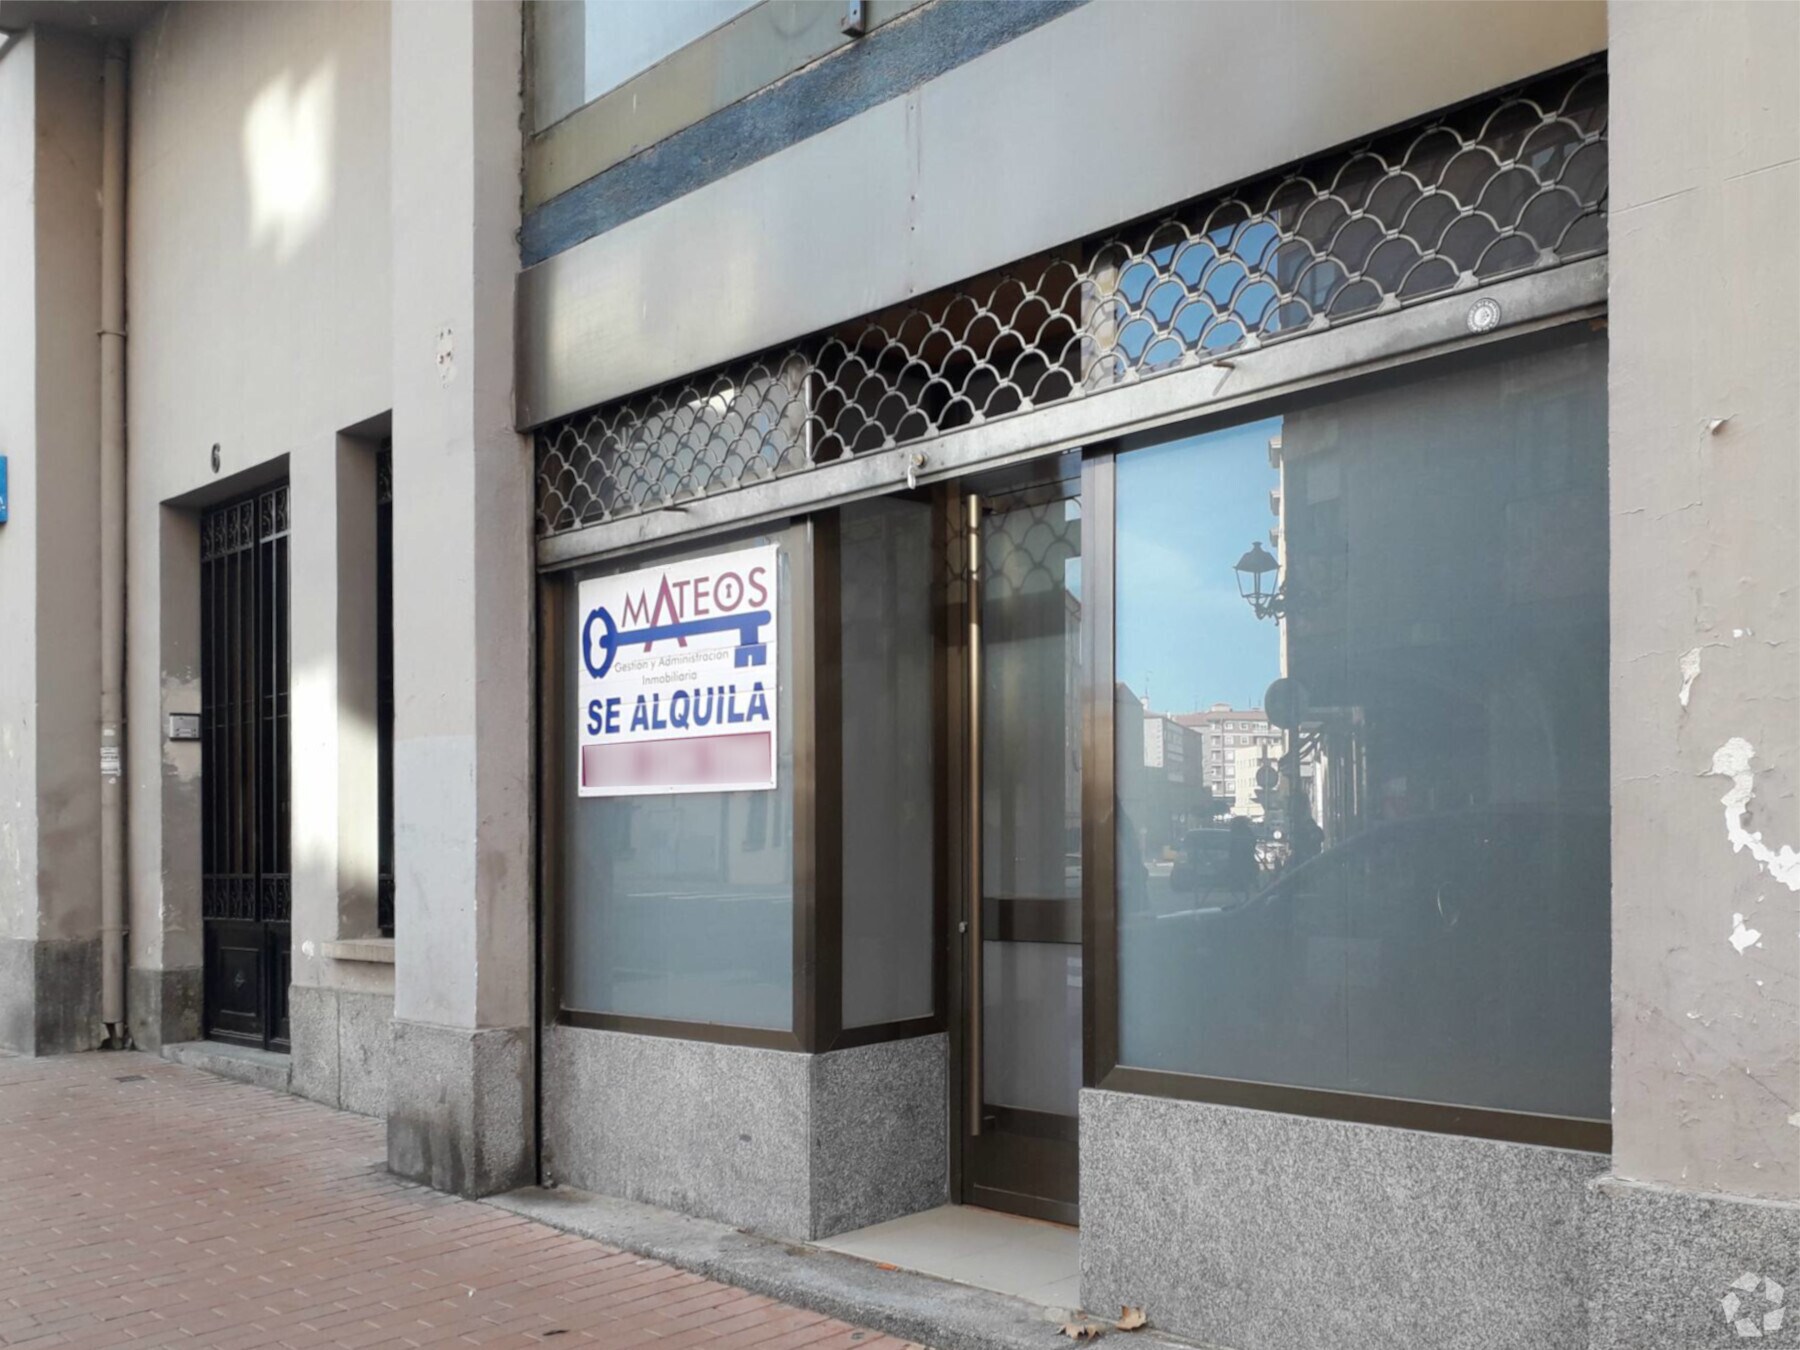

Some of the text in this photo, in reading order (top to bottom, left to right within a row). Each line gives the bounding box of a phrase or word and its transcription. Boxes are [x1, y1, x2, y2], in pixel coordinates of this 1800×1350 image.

[211, 442, 221, 474] 6
[622, 566, 767, 653] MATEOS
[642, 671, 698, 685] Inmobiliaria
[587, 681, 770, 735] SE ALQUILA
